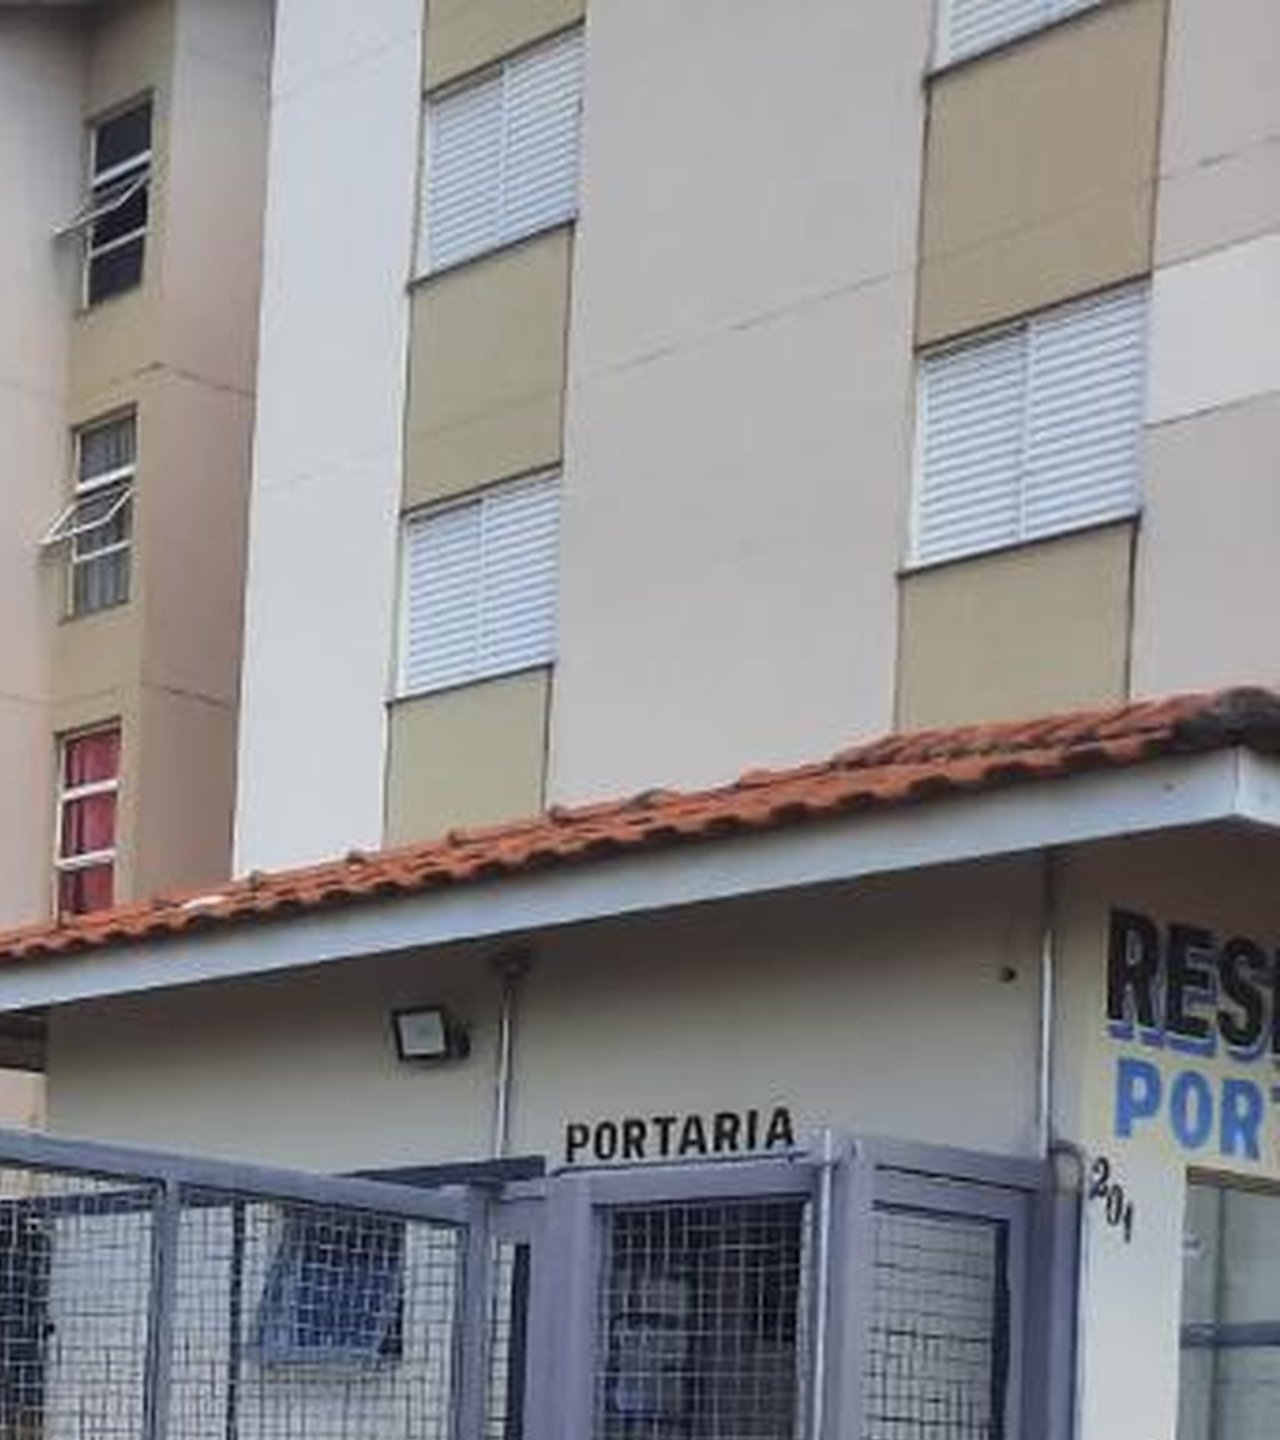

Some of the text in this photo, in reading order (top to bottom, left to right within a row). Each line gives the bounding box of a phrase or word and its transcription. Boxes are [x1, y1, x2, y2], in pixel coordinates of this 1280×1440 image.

[1105, 908, 1280, 1056] RES
[565, 1106, 794, 1163] PORTARIA
[1113, 1057, 1280, 1161] POR
[1090, 1157, 1132, 1243] 201
